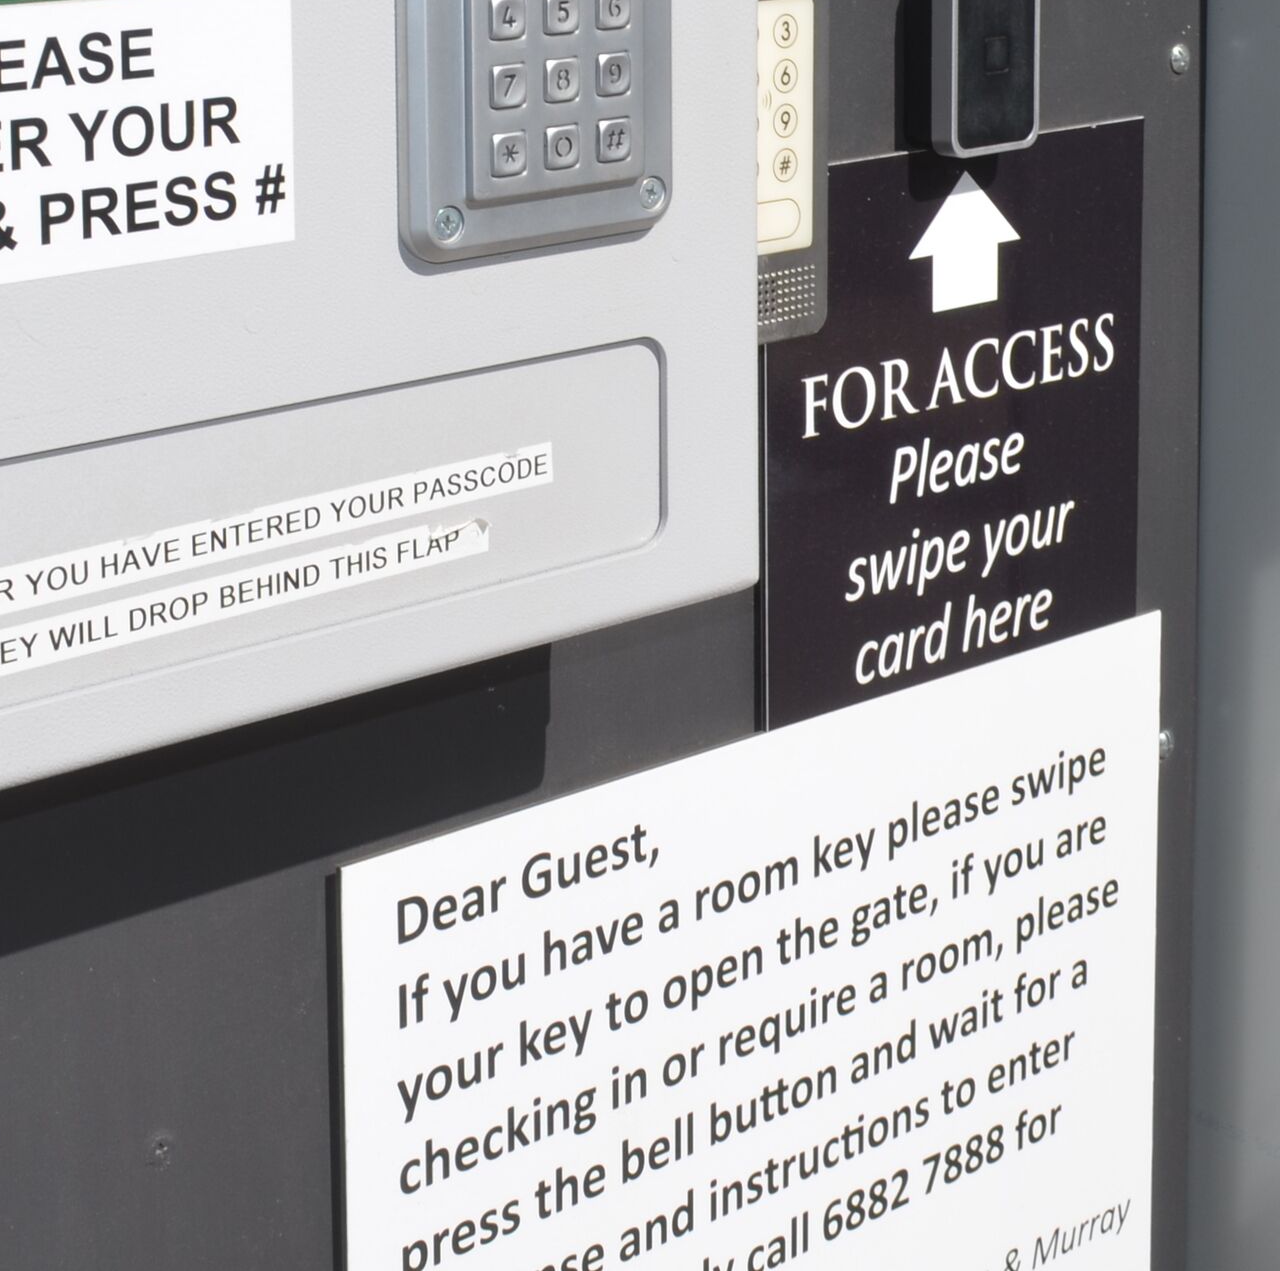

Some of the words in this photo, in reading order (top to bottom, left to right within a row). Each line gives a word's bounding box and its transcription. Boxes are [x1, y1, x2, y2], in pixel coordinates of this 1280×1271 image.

[502, 5, 517, 28] 4
[557, 0, 570, 23] 5
[780, 20, 791, 42] 3
[504, 73, 517, 99] 7
[556, 68, 570, 91] 8
[608, 63, 622, 84] 9
[780, 65, 791, 87] 6
[780, 110, 791, 132] 9
[69, 95, 241, 162] YOUR
[606, 128, 625, 151] #
[779, 154, 792, 175] #
[40, 170, 237, 246] PRESS
[255, 162, 287, 216] #
[801, 358, 919, 439] FOR
[926, 312, 1115, 410] ACCESS
[889, 431, 1025, 505] Please
[25, 560, 89, 596] YOU
[101, 538, 181, 579] HAVE
[191, 506, 321, 557] ENTERED
[330, 487, 405, 523] YOUR
[413, 453, 548, 503] PASSCODE
[844, 527, 971, 602] swipe
[981, 500, 1075, 578] your
[49, 615, 119, 652] WILL
[128, 591, 209, 632] DROP
[219, 564, 321, 609] BEHIND
[329, 546, 388, 581] THIS
[397, 530, 460, 564] FLAP
[855, 600, 952, 685] card
[962, 588, 1053, 653] here
[397, 876, 507, 945] Dear
[521, 824, 660, 899] Guest,
[398, 973, 429, 1030] If
[443, 953, 526, 1022] you
[543, 912, 644, 976] have
[658, 899, 680, 934] a
[695, 856, 799, 921] room
[813, 827, 875, 878] key
[888, 785, 1000, 861] please
[1011, 747, 1106, 806] swipe
[397, 1042, 504, 1124] your
[520, 1009, 593, 1067] key
[606, 990, 649, 1031] to
[663, 945, 764, 1011] open
[777, 916, 839, 965] the
[851, 882, 939, 947] gate,
[951, 853, 974, 899] if
[984, 838, 1045, 896] you
[1056, 815, 1107, 858] are
[400, 1087, 597, 1195] checking
[611, 1066, 647, 1110] in
[663, 1043, 705, 1087] or
[719, 984, 856, 1065] require
[869, 971, 888, 1004] a
[901, 929, 1004, 992] room,
[1017, 879, 1119, 954] please
[402, 1199, 521, 1271] press
[535, 1163, 607, 1219] the
[622, 1112, 694, 1184] bell
[710, 1065, 837, 1146] button
[851, 1019, 917, 1084] and
[929, 989, 1004, 1050] wait
[1014, 968, 1061, 1015] for
[1071, 959, 1088, 990] a
[619, 1188, 694, 1262] and
[710, 1097, 930, 1222] instructions
[941, 1077, 976, 1115] to
[988, 1031, 1076, 1095] enter
[747, 1211, 809, 1271] call
[823, 1168, 910, 1241] 6882
[922, 1124, 1005, 1195] 7888
[1014, 1104, 1062, 1151] for
[1032, 1198, 1131, 1270] Murray
